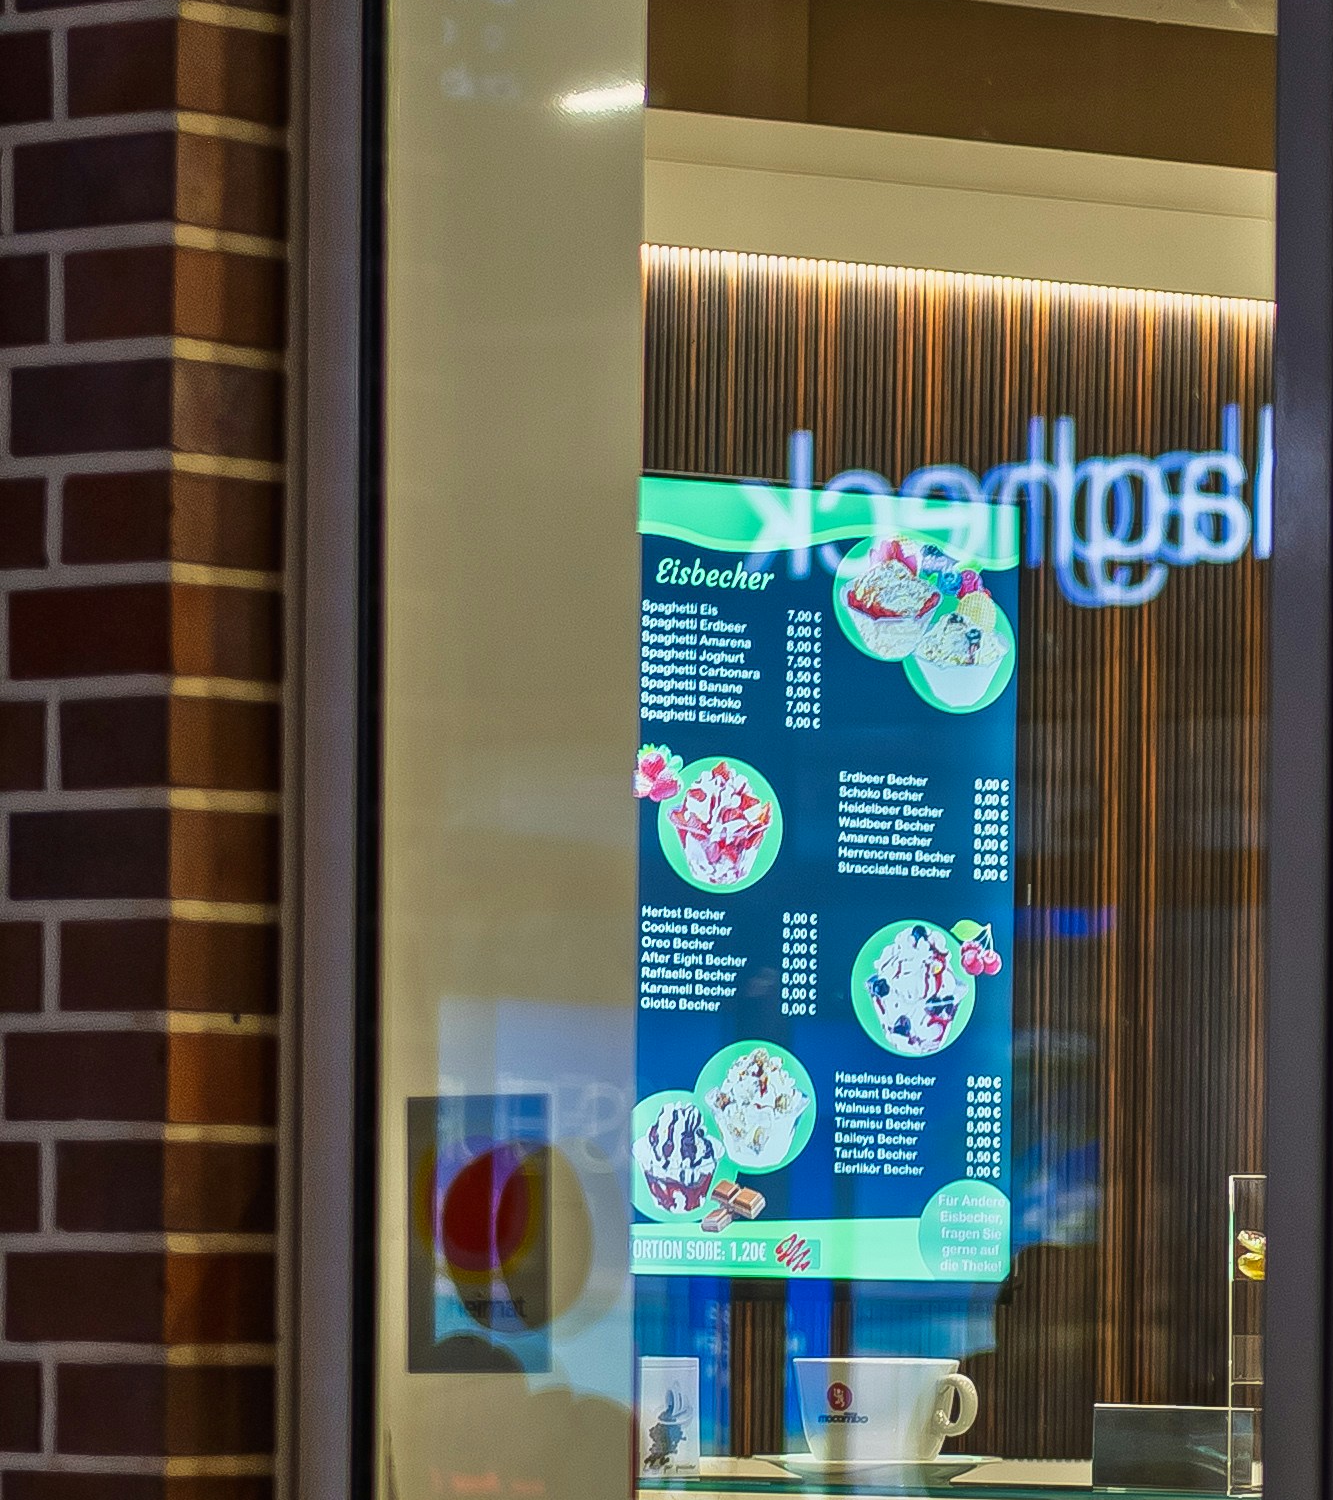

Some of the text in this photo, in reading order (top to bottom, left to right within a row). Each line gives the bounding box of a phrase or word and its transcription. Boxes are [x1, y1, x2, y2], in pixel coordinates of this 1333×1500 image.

[656, 558, 774, 590] Eisbecher
[642, 599, 697, 615] Spaghetti
[700, 604, 718, 616] Eis
[642, 615, 697, 631] Spaghetti
[700, 619, 747, 633] Erdbeer
[642, 630, 697, 646] Spaghetti
[700, 635, 751, 649] Amarena
[641, 646, 696, 662] Spaghetti
[699, 650, 745, 664] Joghurt
[641, 661, 696, 677] Spaghetti
[699, 665, 760, 680] Carbonara
[641, 676, 696, 692] Spaghetti
[699, 680, 742, 694] Banane
[641, 691, 696, 707] Spaghetti
[699, 696, 741, 709] Schoko
[641, 707, 695, 722] Spaghetti
[699, 711, 747, 725] Eierlikör
[839, 771, 885, 784] Erdbeer
[887, 774, 928, 787] Becher
[839, 786, 880, 799] Schoko
[883, 788, 924, 802] Becher
[839, 801, 901, 815] Heidelbeer
[903, 805, 944, 818] Becher
[839, 816, 892, 830] Waldbeer
[895, 820, 935, 832] Becher
[838, 831, 889, 845] Amarena
[892, 834, 932, 847] Becher
[838, 846, 912, 861] Herrencreme
[915, 850, 955, 863] Becher
[838, 861, 908, 876] Stracciatella
[911, 865, 951, 878] Becher
[642, 905, 681, 919] Herbst
[684, 908, 725, 921] Becher
[642, 921, 688, 934] Cookies
[691, 923, 732, 936] Becher
[642, 936, 670, 949] Oreo
[673, 938, 714, 950] Becher
[641, 951, 671, 964] After
[674, 952, 703, 967] Eight
[706, 954, 747, 967] Becher
[641, 967, 692, 979] Raffaello
[695, 969, 736, 982] Becher
[641, 982, 692, 995] Karamell
[695, 984, 736, 997] Becher
[641, 997, 676, 1010] Giotto
[679, 998, 720, 1012] Becher
[835, 1071, 893, 1084] Haselnuss
[896, 1073, 936, 1086] Becher
[835, 1087, 879, 1099] Krokant
[882, 1088, 922, 1100] Becher
[835, 1102, 881, 1114] Walnuss
[884, 1103, 924, 1115] Becher
[835, 1117, 883, 1129] Tiramisu
[886, 1118, 926, 1131] Becher
[834, 1132, 874, 1146] Baileys
[877, 1133, 918, 1145] Becher
[834, 1147, 874, 1159] Tartufo
[877, 1148, 918, 1160] Becher
[834, 1162, 881, 1175] Eierlikör
[884, 1163, 924, 1176] Becher
[817, 1414, 869, 1424] mocambo
